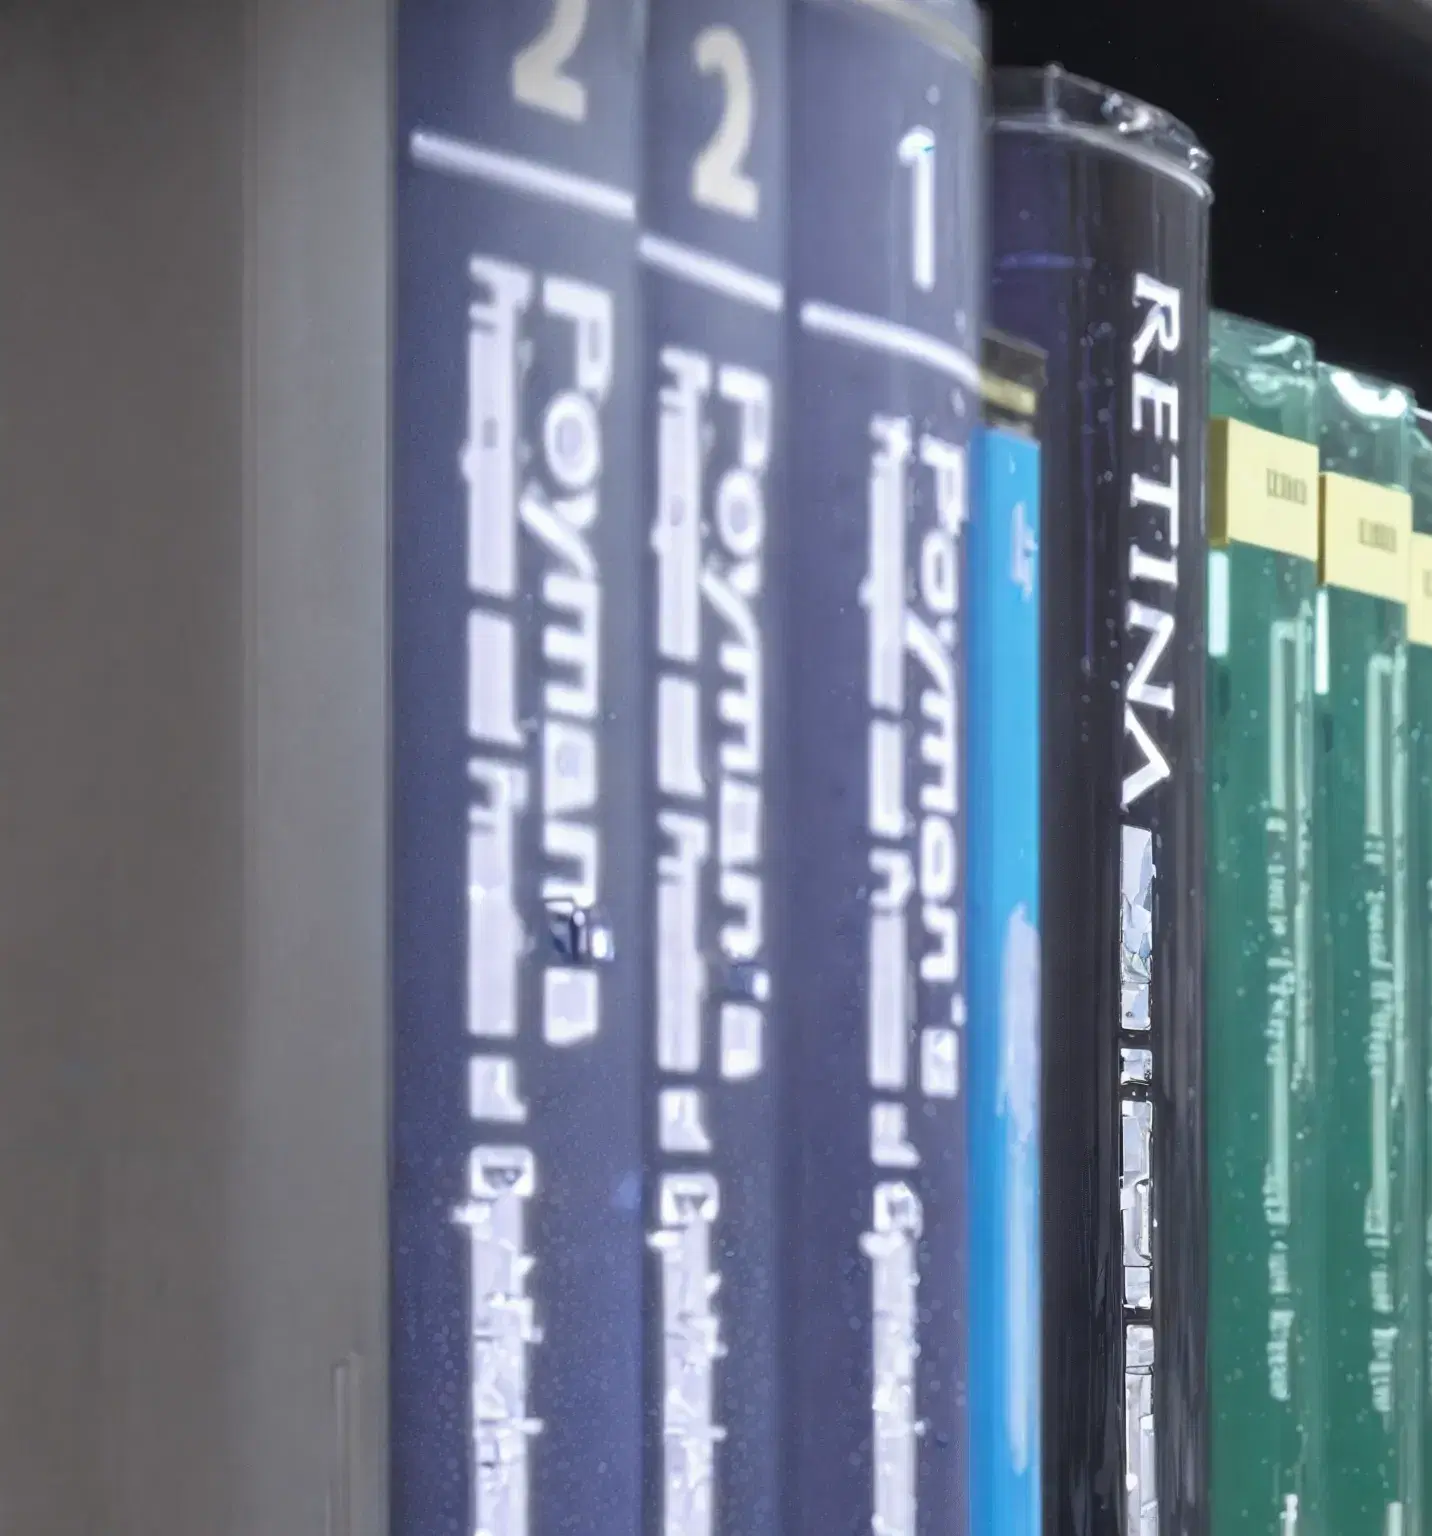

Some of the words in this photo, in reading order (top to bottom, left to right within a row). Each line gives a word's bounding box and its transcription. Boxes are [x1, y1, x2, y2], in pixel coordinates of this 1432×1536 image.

[513, 0, 587, 121] 2
[692, 26, 759, 217] 2
[898, 125, 936, 290] 1
[1120, 273, 1182, 811] RETINA
